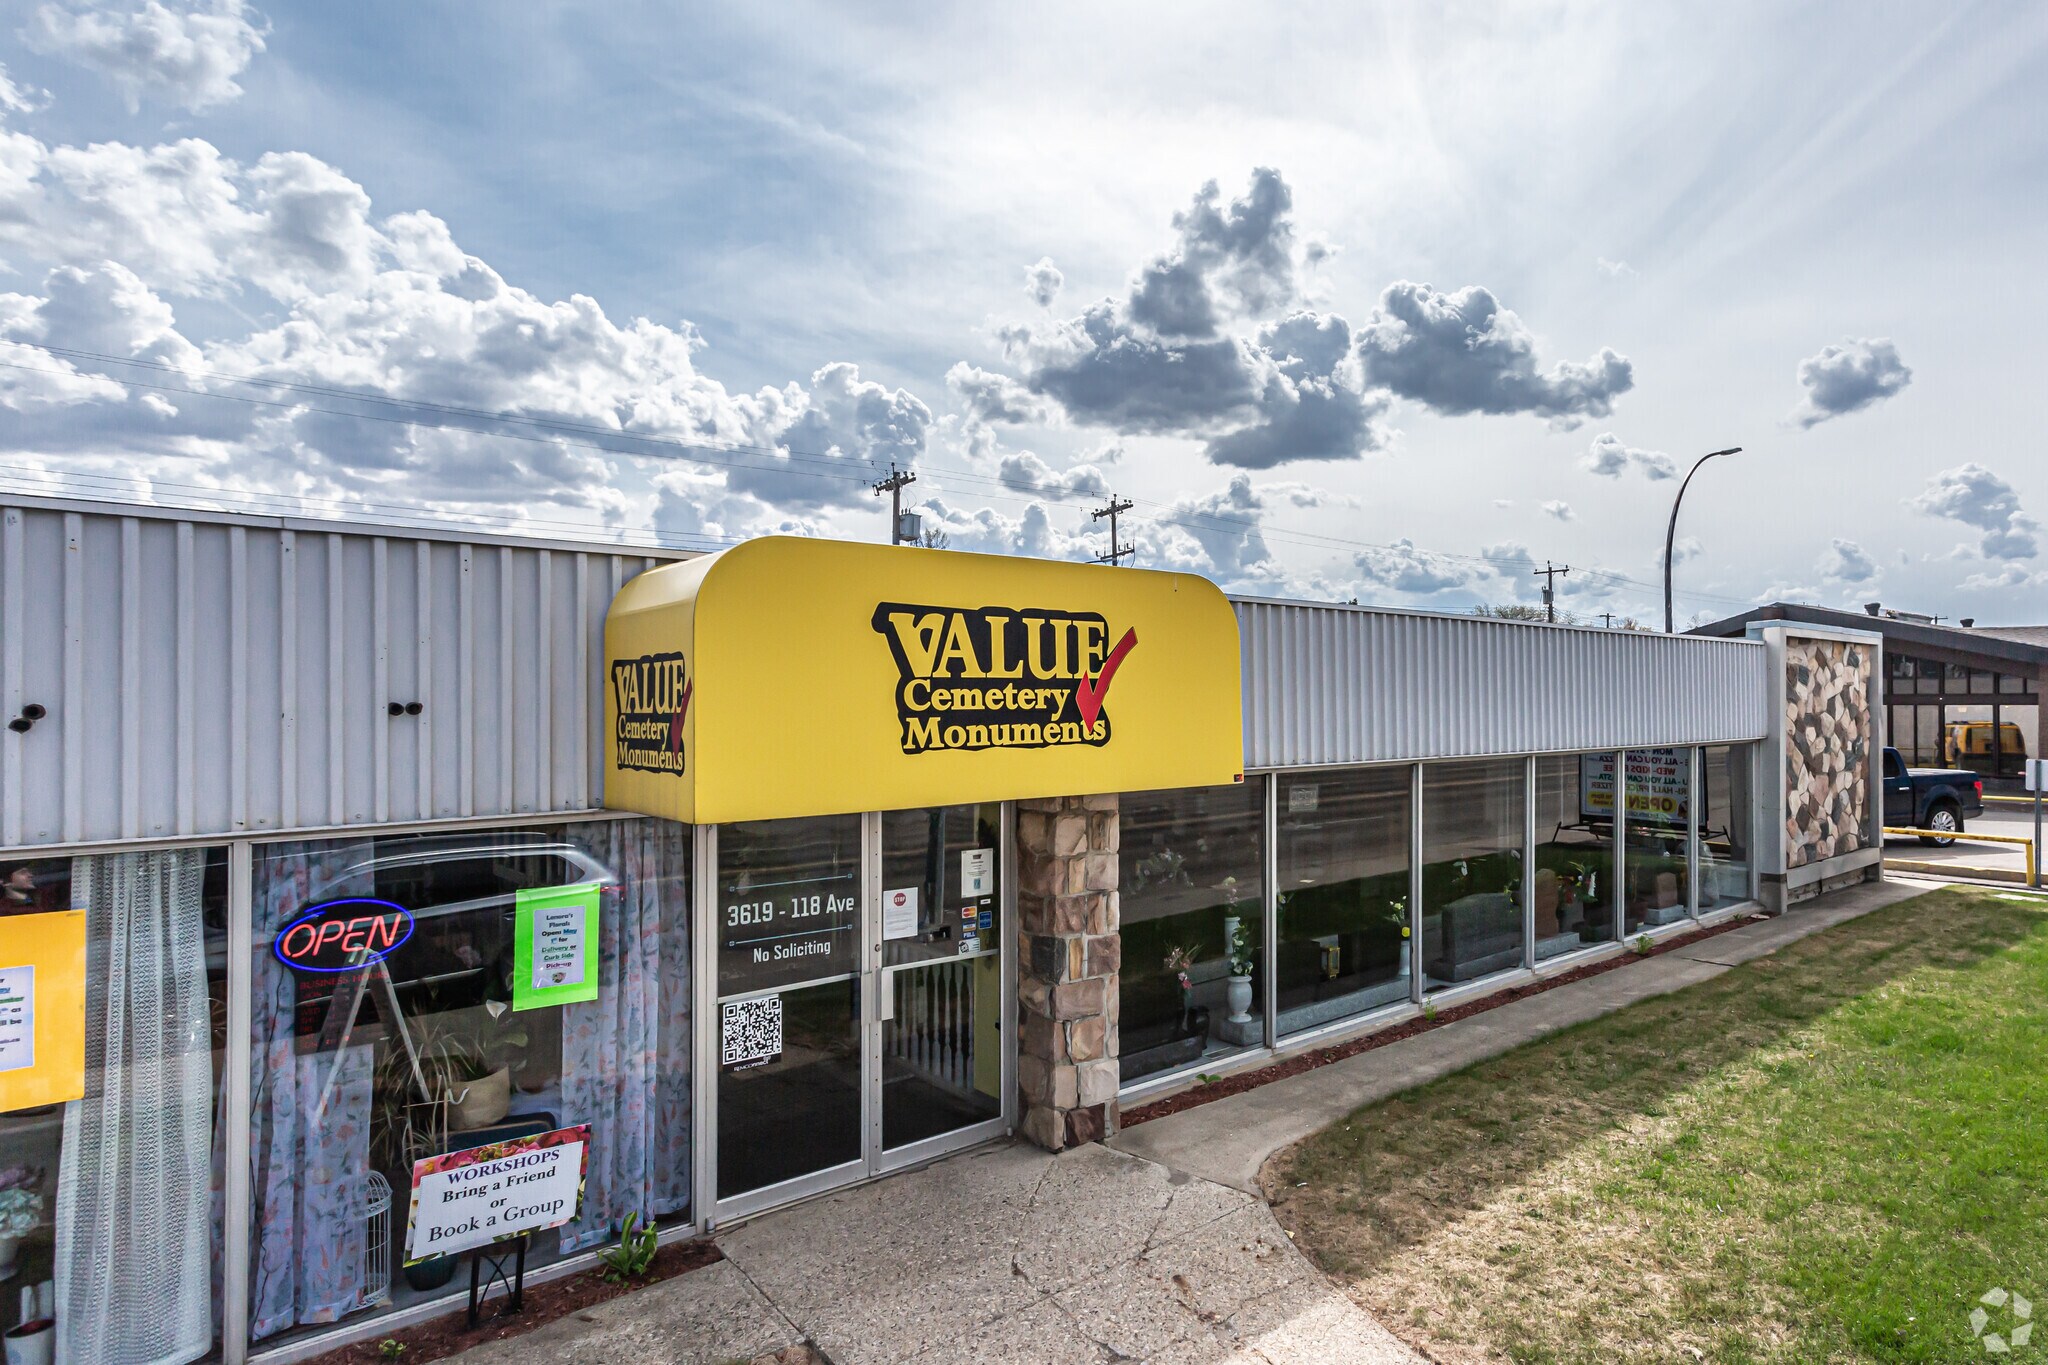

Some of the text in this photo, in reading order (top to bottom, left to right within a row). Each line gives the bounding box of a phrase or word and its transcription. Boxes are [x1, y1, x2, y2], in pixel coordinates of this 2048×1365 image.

[889, 612, 1107, 680] VALUE
[616, 659, 683, 714] VALUE
[904, 679, 1070, 721] Cemetery
[618, 715, 669, 751] Cemetery
[904, 717, 1105, 749] Monuments
[618, 741, 683, 770] Monuments
[728, 901, 773, 926] 3619
[791, 896, 820, 918] 118
[826, 894, 854, 914] Ave
[895, 895, 906, 903] STOP
[283, 914, 401, 958] OPEN
[754, 941, 831, 963] No Soliciting
[442, 1166, 556, 1203] Bring a Friend
[447, 1150, 560, 1185] WORKSHOPS
[428, 1199, 563, 1242] Book a Group
[490, 1198, 507, 1209] or
